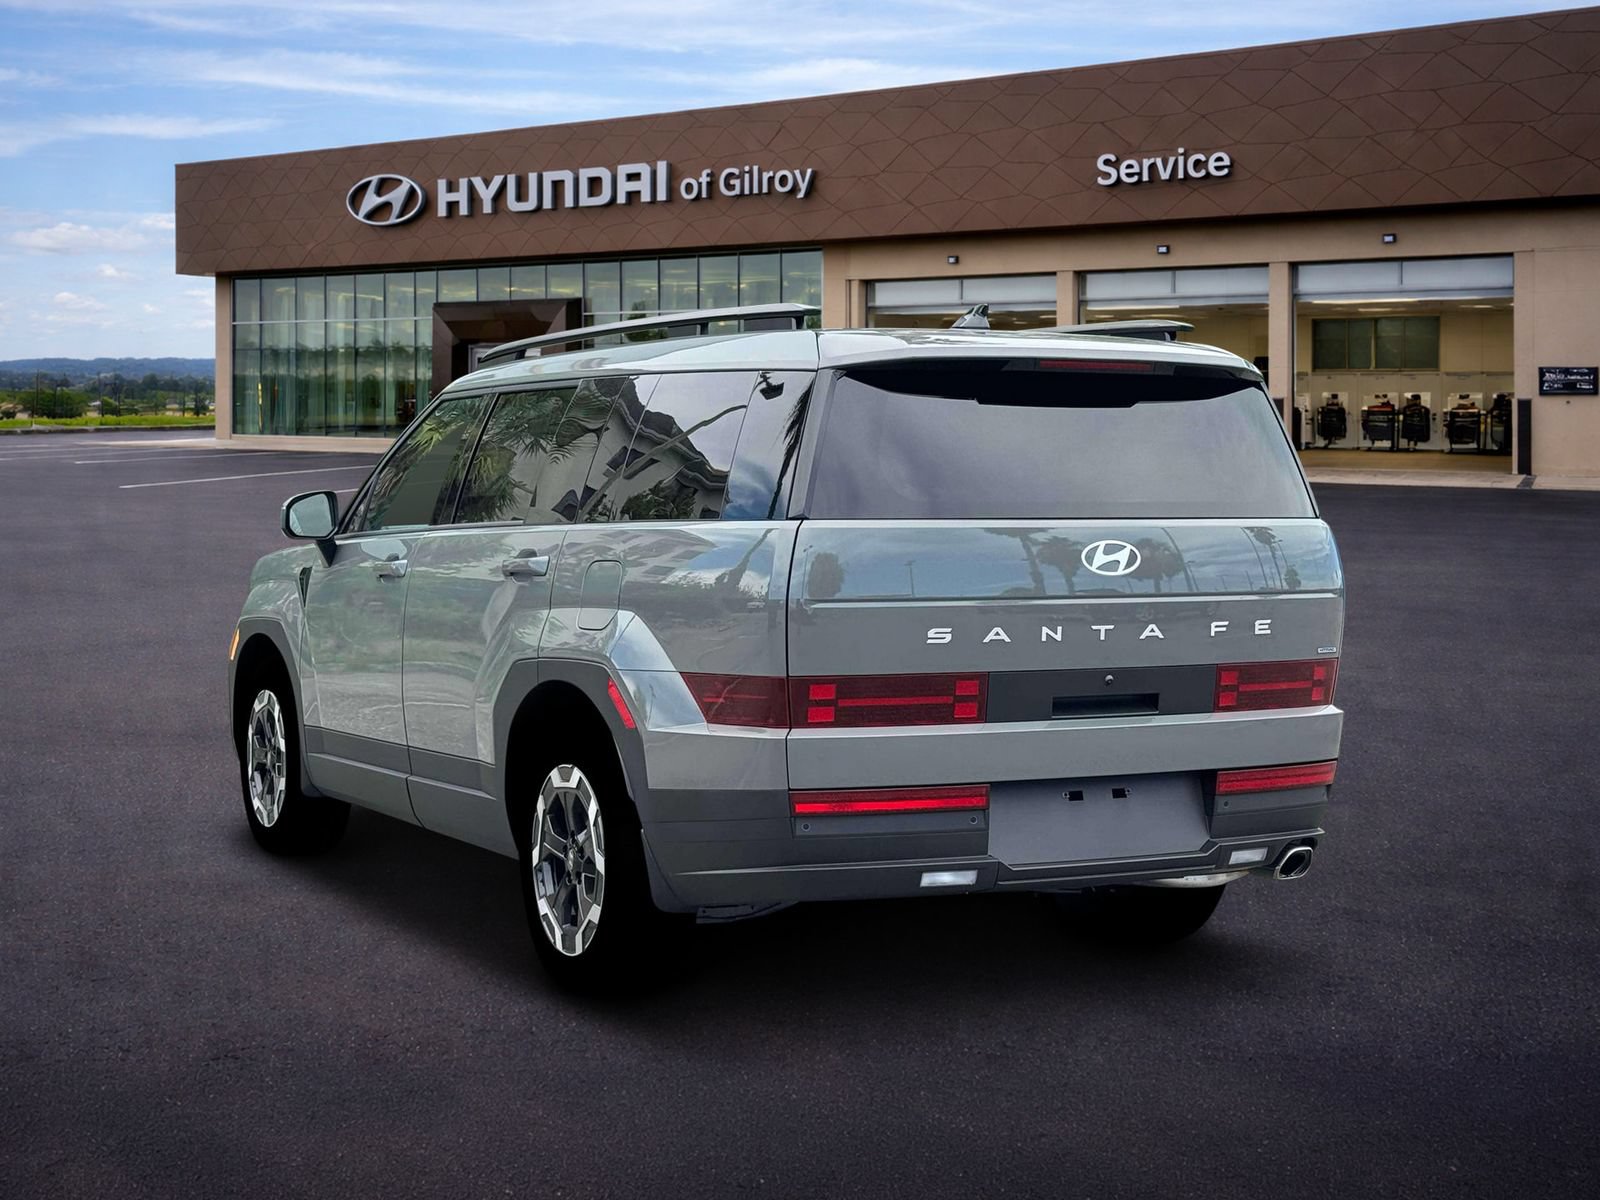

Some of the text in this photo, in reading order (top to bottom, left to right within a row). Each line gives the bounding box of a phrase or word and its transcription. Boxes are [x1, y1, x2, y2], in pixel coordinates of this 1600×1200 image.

[1096, 147, 1232, 186] Service
[436, 160, 815, 217] HYUNDAI of Gilroy
[926, 619, 1273, 645] SANTA FE
